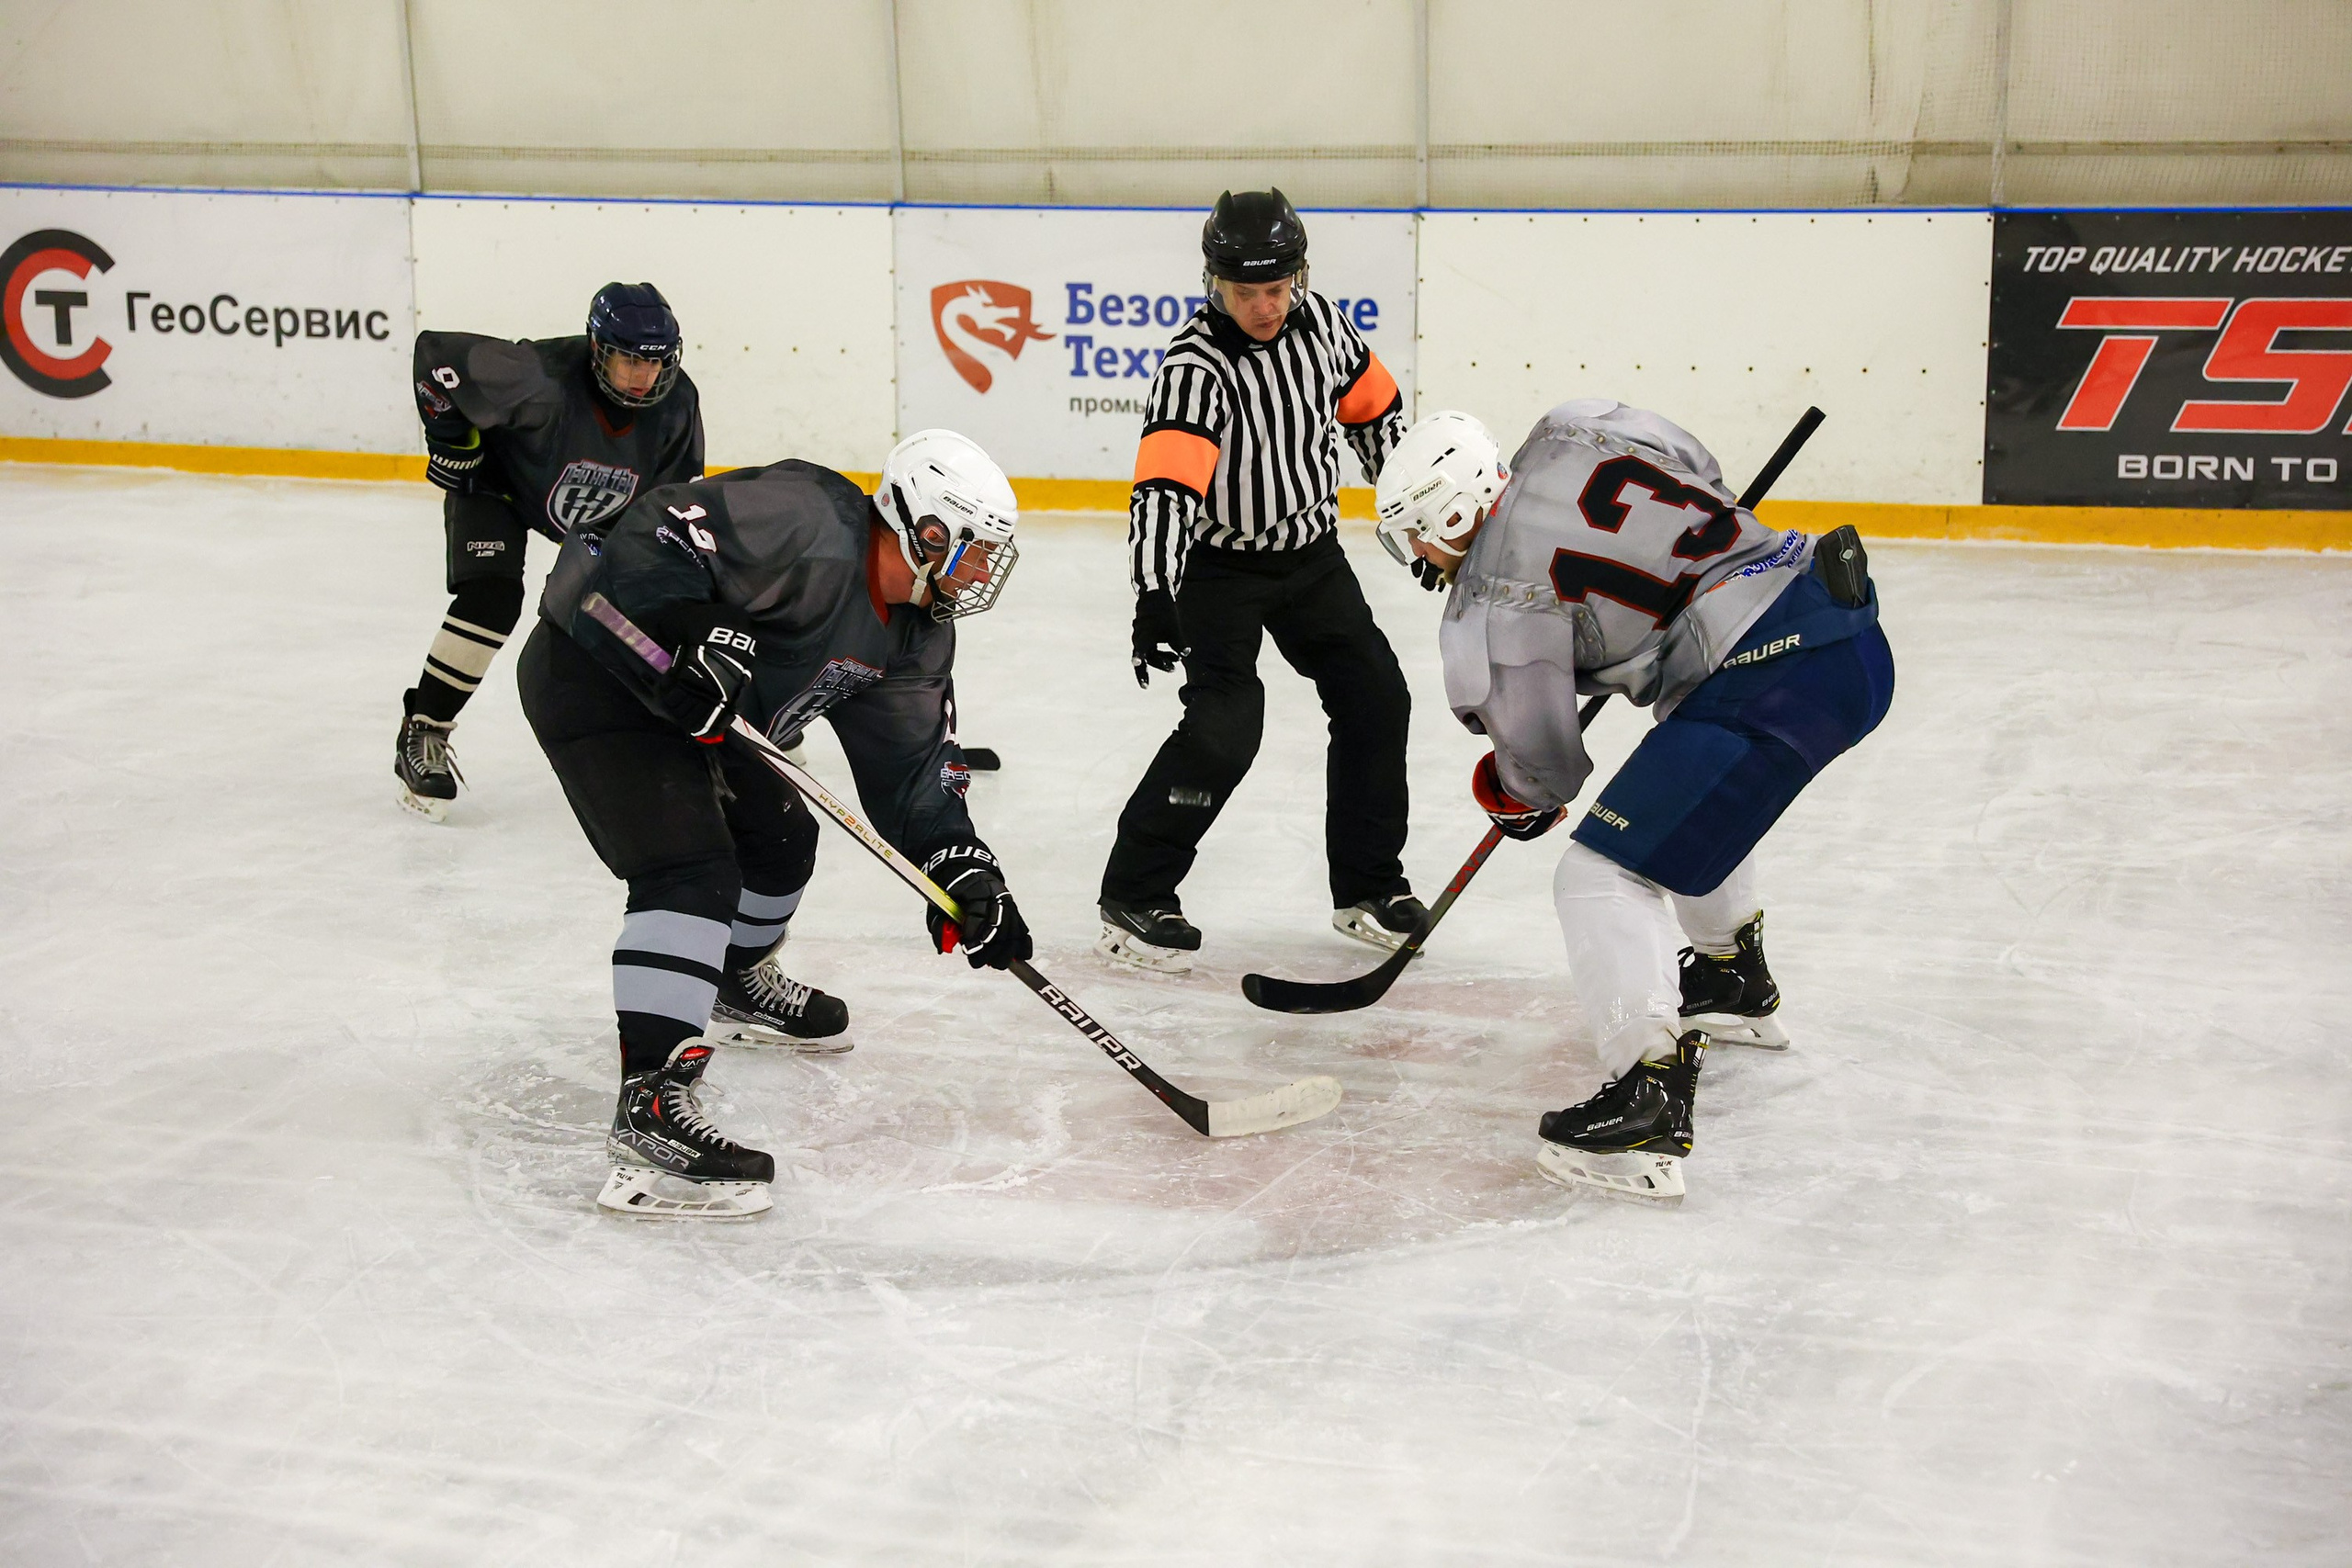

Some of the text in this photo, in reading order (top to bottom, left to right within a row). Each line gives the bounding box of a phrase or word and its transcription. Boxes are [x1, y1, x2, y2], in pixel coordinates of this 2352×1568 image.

[1242, 258, 1277, 266] BAUER
[2024, 246, 2352, 275] TOP QUALITY HOCKE
[126, 291, 390, 347] ГеоСервис
[2055, 297, 2352, 434] TS
[2118, 455, 2338, 482] BORN TO
[943, 495, 974, 515] BAUER
[908, 528, 924, 558] BAUER
[1548, 454, 1743, 632] 13
[819, 793, 894, 860] HYP2RLITE
[1446, 823, 1503, 894] VAPO
[1038, 984, 1142, 1072] BAUER
[1586, 1116, 1624, 1132] BAUER
